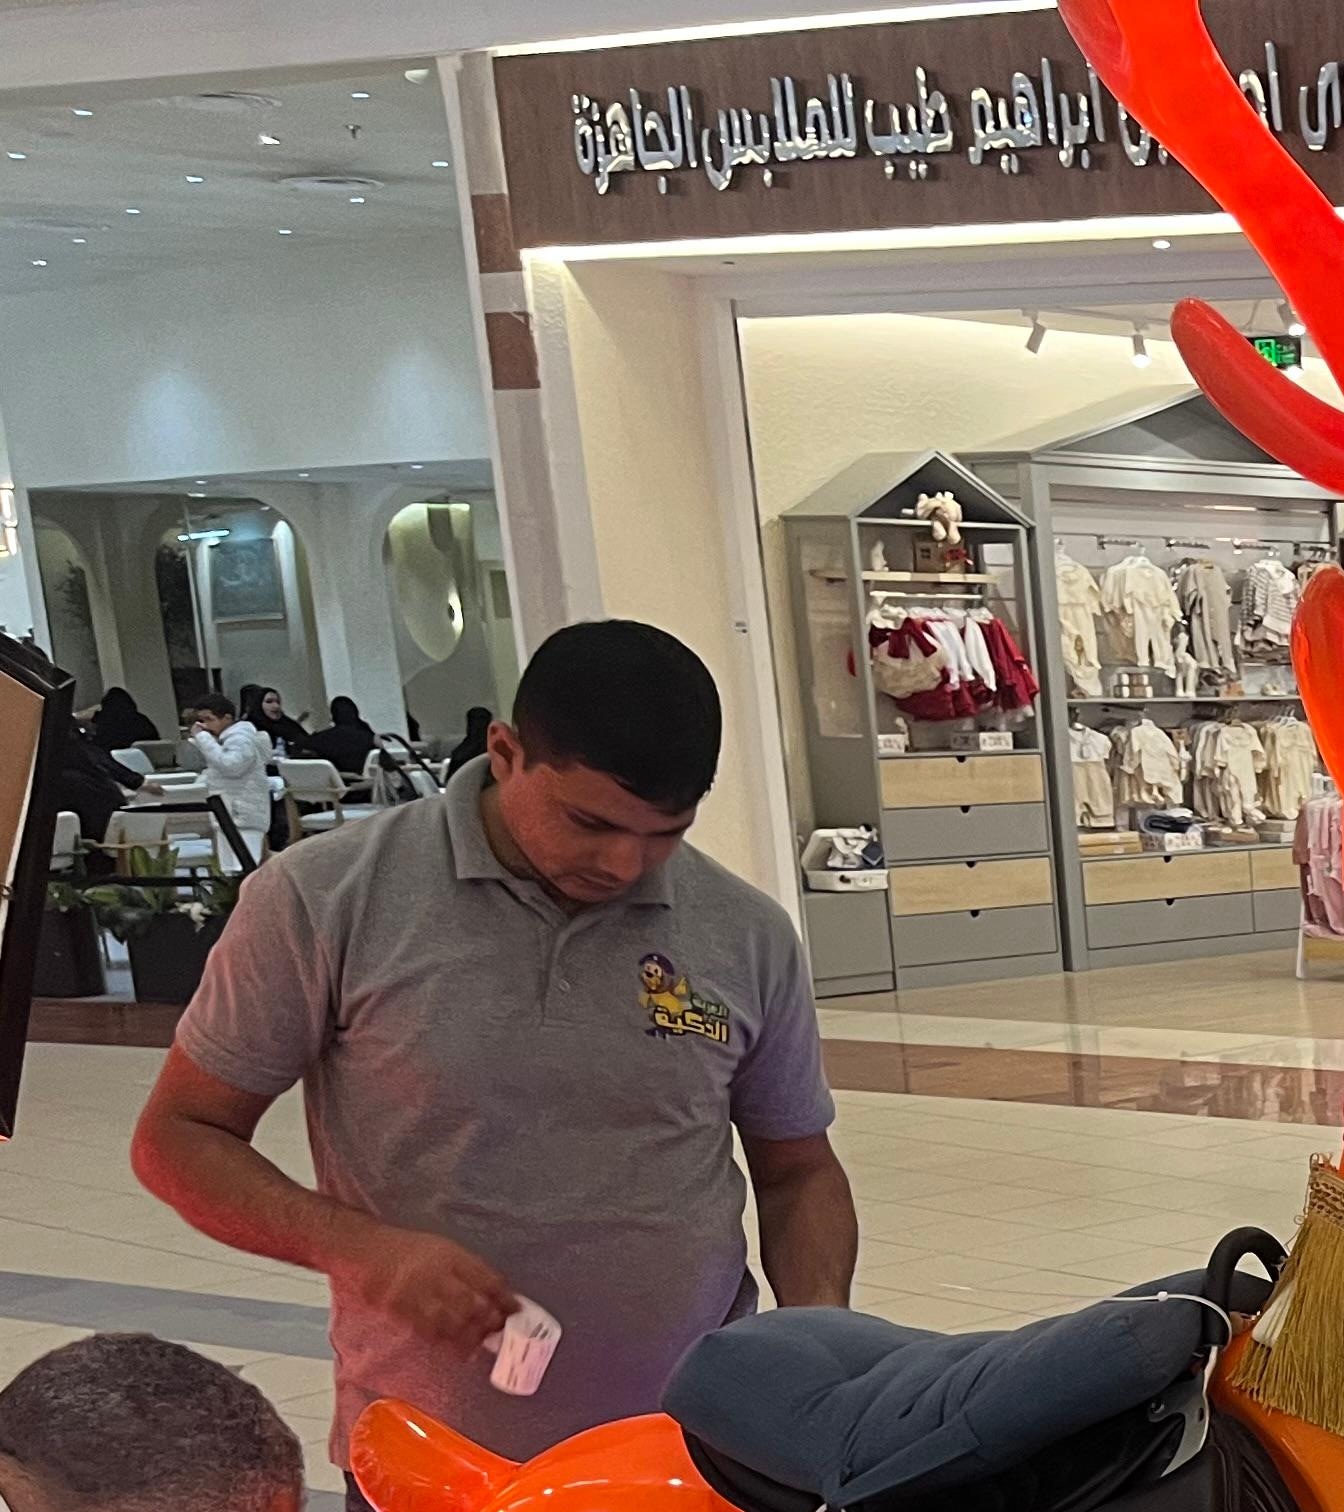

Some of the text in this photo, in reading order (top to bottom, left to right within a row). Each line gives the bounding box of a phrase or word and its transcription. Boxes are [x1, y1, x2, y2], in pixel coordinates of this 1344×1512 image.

[571, 84, 699, 195] الجاهزة
[702, 72, 857, 192] للملابس
[863, 65, 953, 181] طيب
